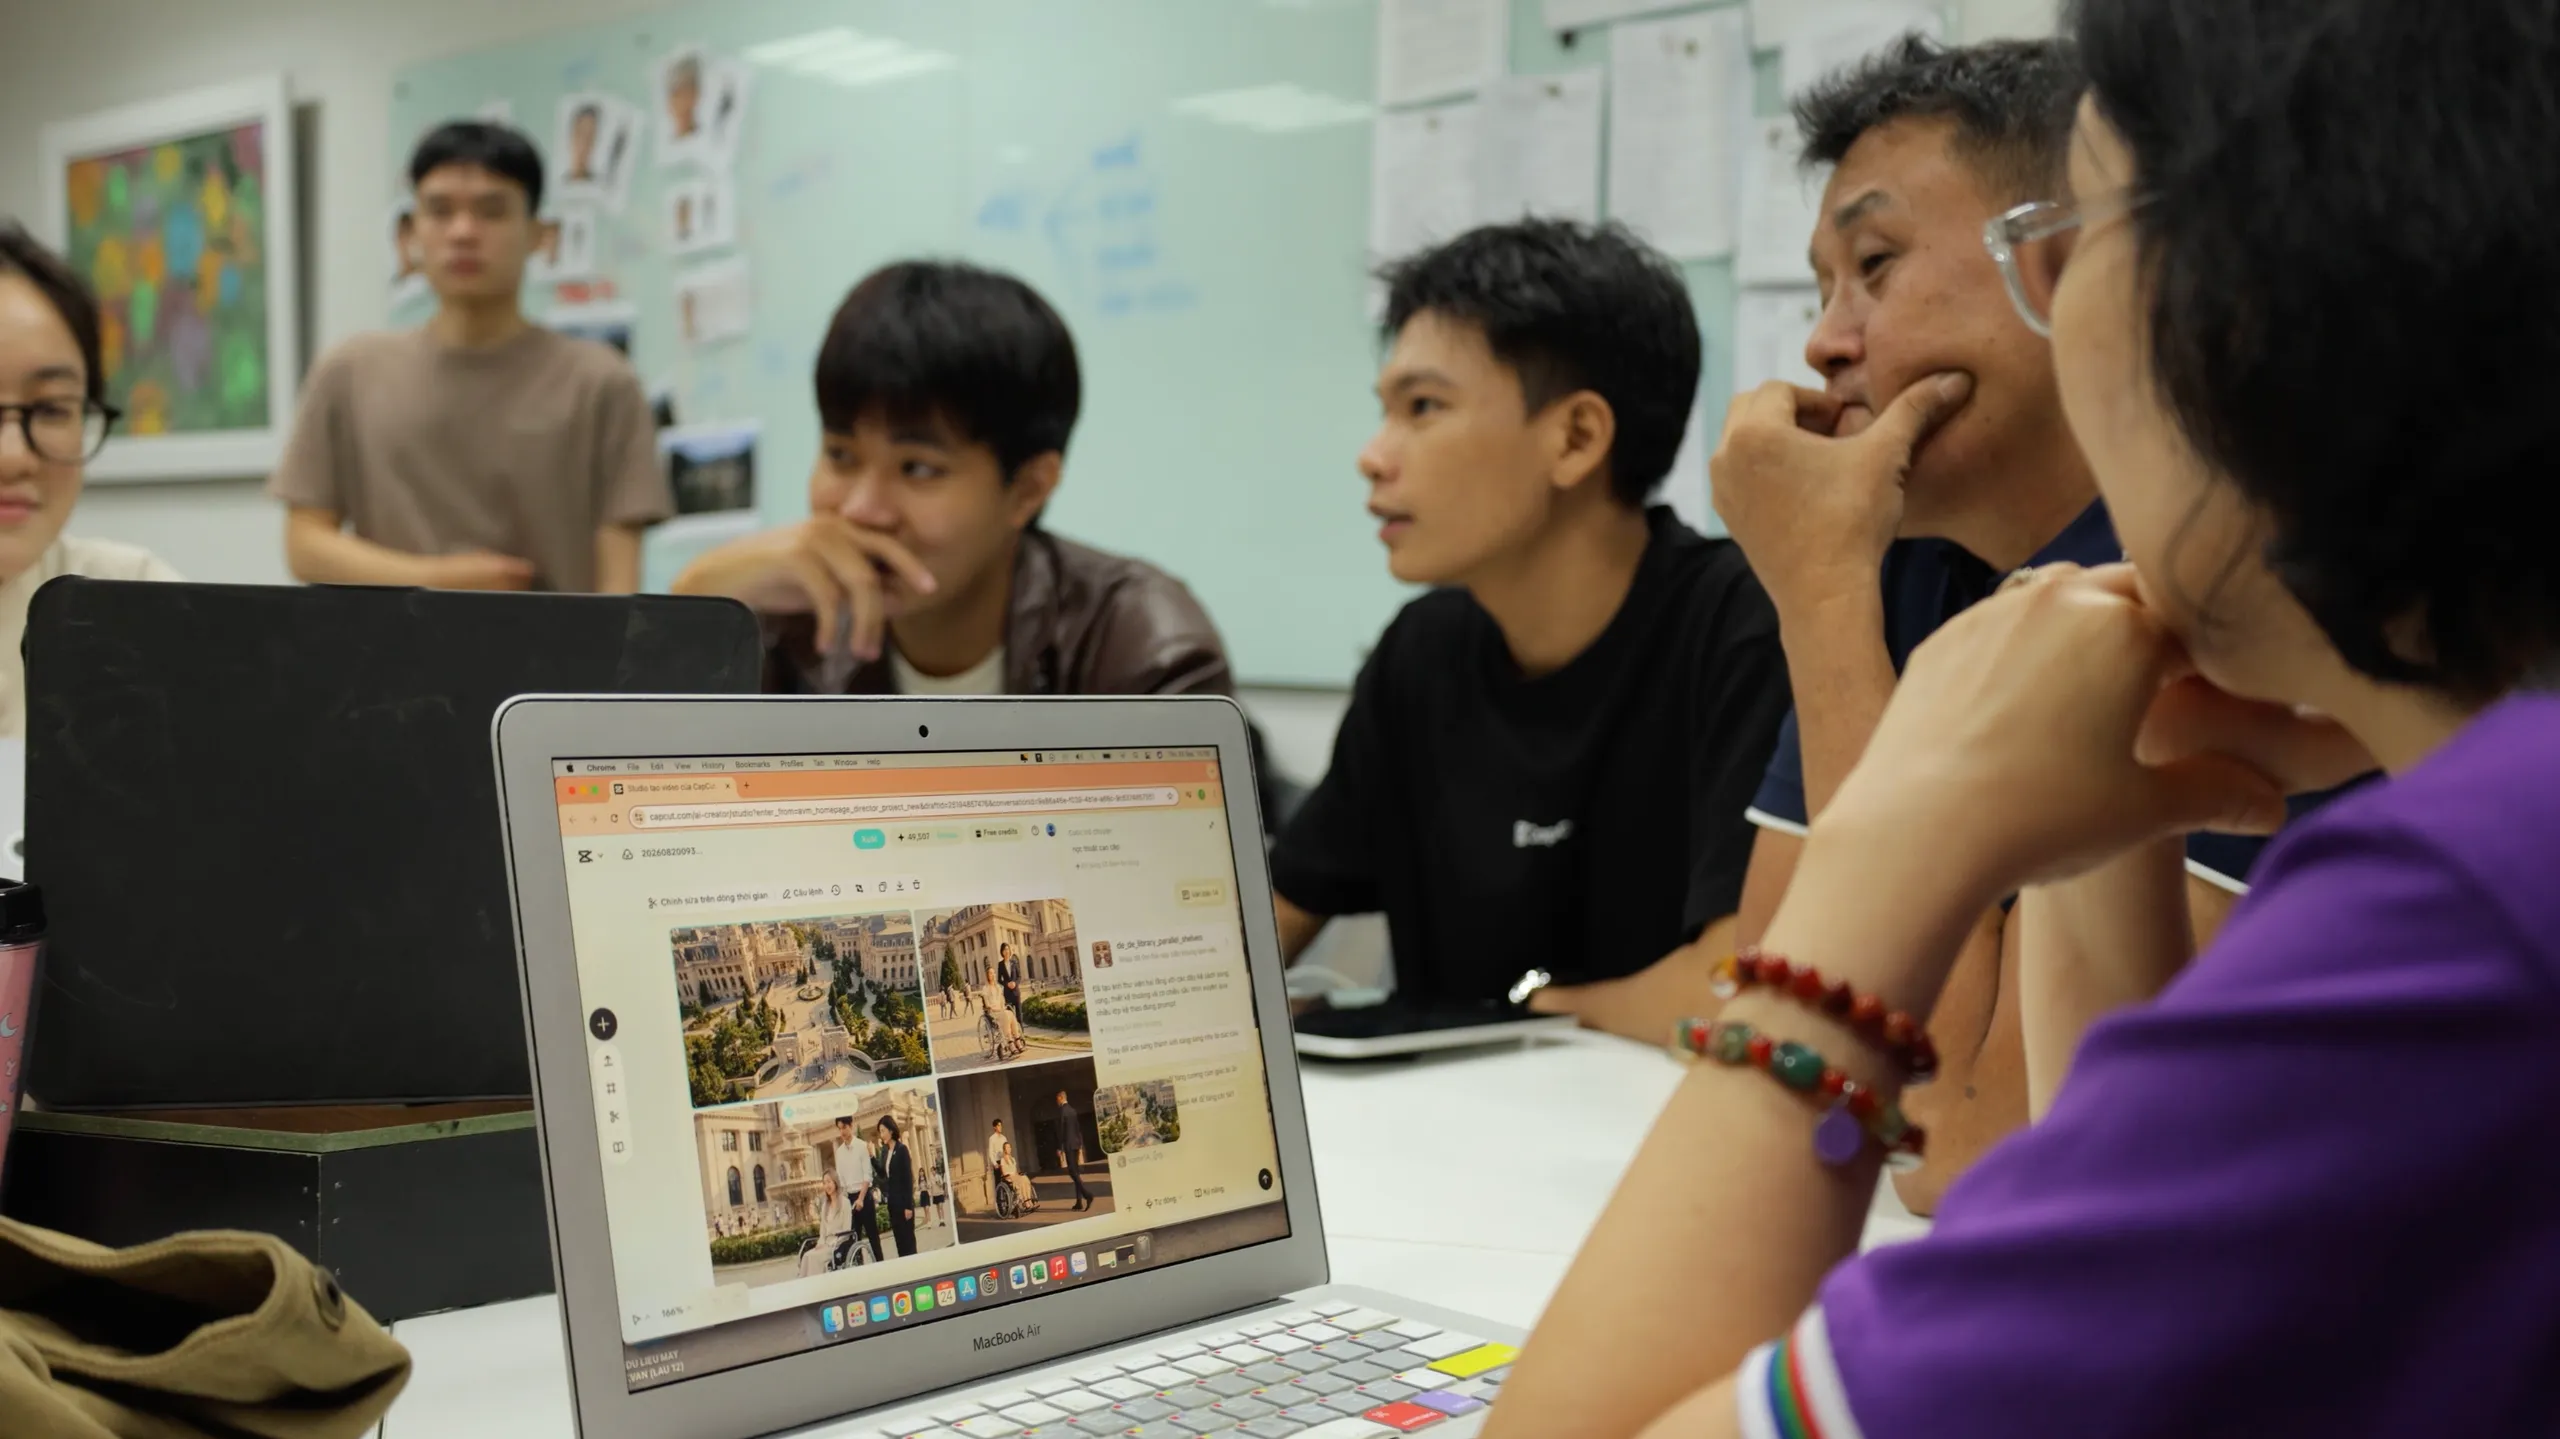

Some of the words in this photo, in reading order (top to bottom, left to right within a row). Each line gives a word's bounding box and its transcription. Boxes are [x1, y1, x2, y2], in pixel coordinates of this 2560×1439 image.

[586, 763, 617, 772] Chrome
[627, 762, 640, 771] File
[650, 762, 664, 771] Edit
[674, 762, 691, 770] View
[701, 761, 726, 771] History
[734, 760, 771, 769] Bookmarks
[780, 759, 804, 768] Profiles
[813, 758, 825, 767] Tab
[833, 758, 858, 767] Window
[866, 757, 881, 767] Help
[627, 784, 649, 793] Studio
[662, 783, 679, 792] video
[983, 829, 997, 837] Free
[997, 827, 1019, 836] credits
[752, 892, 769, 903] gian
[940, 1290, 953, 1303] 24
[972, 1326, 1025, 1353] MacBook
[1025, 1322, 1042, 1338] Air
[626, 1358, 639, 1370] DU
[639, 1354, 659, 1367] LIEU
[660, 1350, 679, 1363] MAY
[650, 1365, 670, 1379] (LAU
[671, 1361, 684, 1373] 12)
